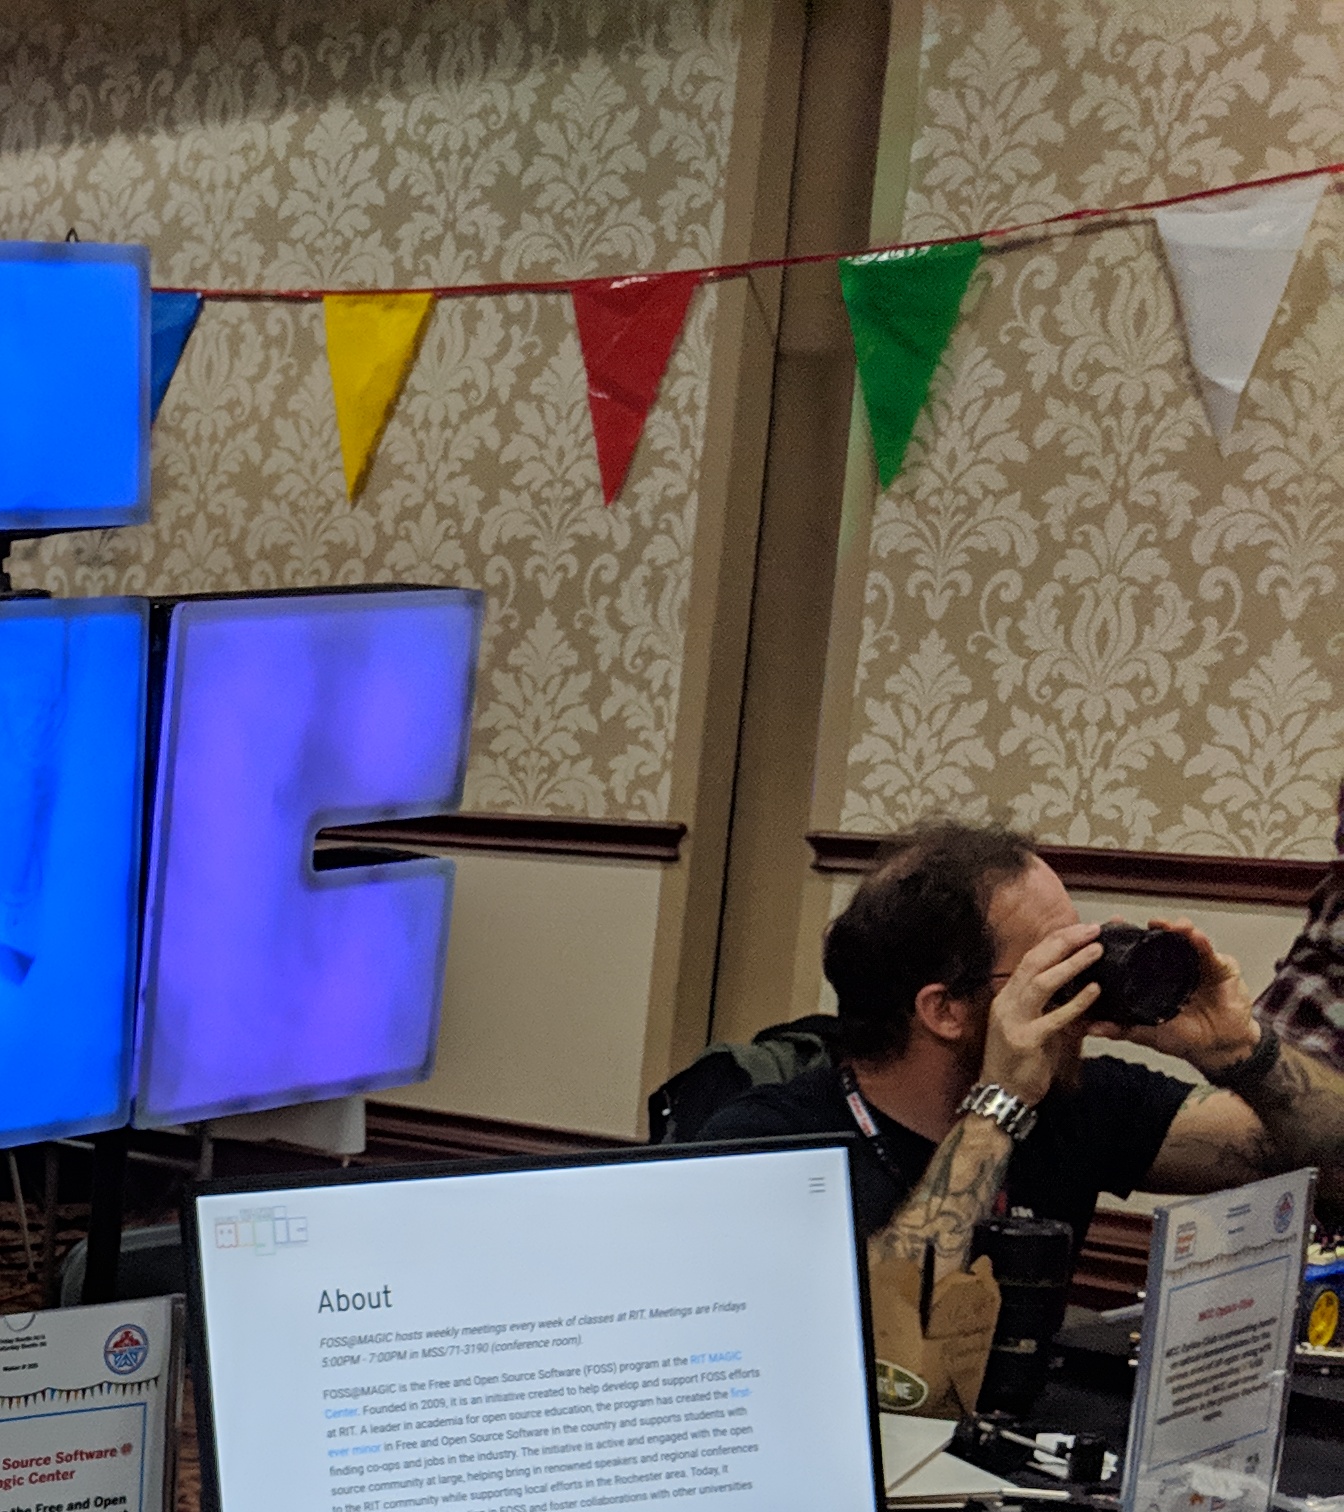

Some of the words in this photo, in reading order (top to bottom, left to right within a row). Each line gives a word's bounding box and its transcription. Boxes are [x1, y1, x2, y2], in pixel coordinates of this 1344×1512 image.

[318, 1284, 394, 1314] About
[320, 1332, 394, 1349] FOSS@MAGIC
[395, 1329, 423, 1342] hosts
[425, 1326, 460, 1341] weekly
[462, 1321, 508, 1337] meetings
[509, 1320, 537, 1334] every
[538, 1317, 564, 1329] week
[566, 1316, 577, 1327] of
[578, 1313, 614, 1326] classes
[617, 1311, 628, 1322] at
[649, 1304, 694, 1320] Meetings
[695, 1305, 711, 1315] are
[712, 1300, 748, 1314] Fridays
[322, 1355, 361, 1369] 5:00PM
[369, 1350, 408, 1364] 7:00PM
[410, 1349, 419, 1359] in
[491, 1338, 551, 1353] (conference
[323, 1383, 397, 1400] FOSS@MAGIC
[399, 1382, 408, 1392] is
[410, 1380, 427, 1392] the
[428, 1378, 452, 1390] Free
[454, 1376, 472, 1387] and
[473, 1374, 499, 1387] Open
[502, 1369, 536, 1383] Source
[538, 1366, 582, 1380] Software
[583, 1362, 618, 1377] (FOSS)
[619, 1358, 660, 1374] program
[662, 1357, 672, 1368] at
[673, 1355, 689, 1367] the
[690, 1353, 706, 1365] RIT
[708, 1350, 743, 1363] MAGIC
[2, 1456, 52, 1472] Source
[55, 1446, 117, 1465] Software
[120, 1442, 133, 1456] @
[28, 1468, 76, 1484] Center
[66, 1498, 90, 1512] and
[93, 1494, 127, 1510] Open
